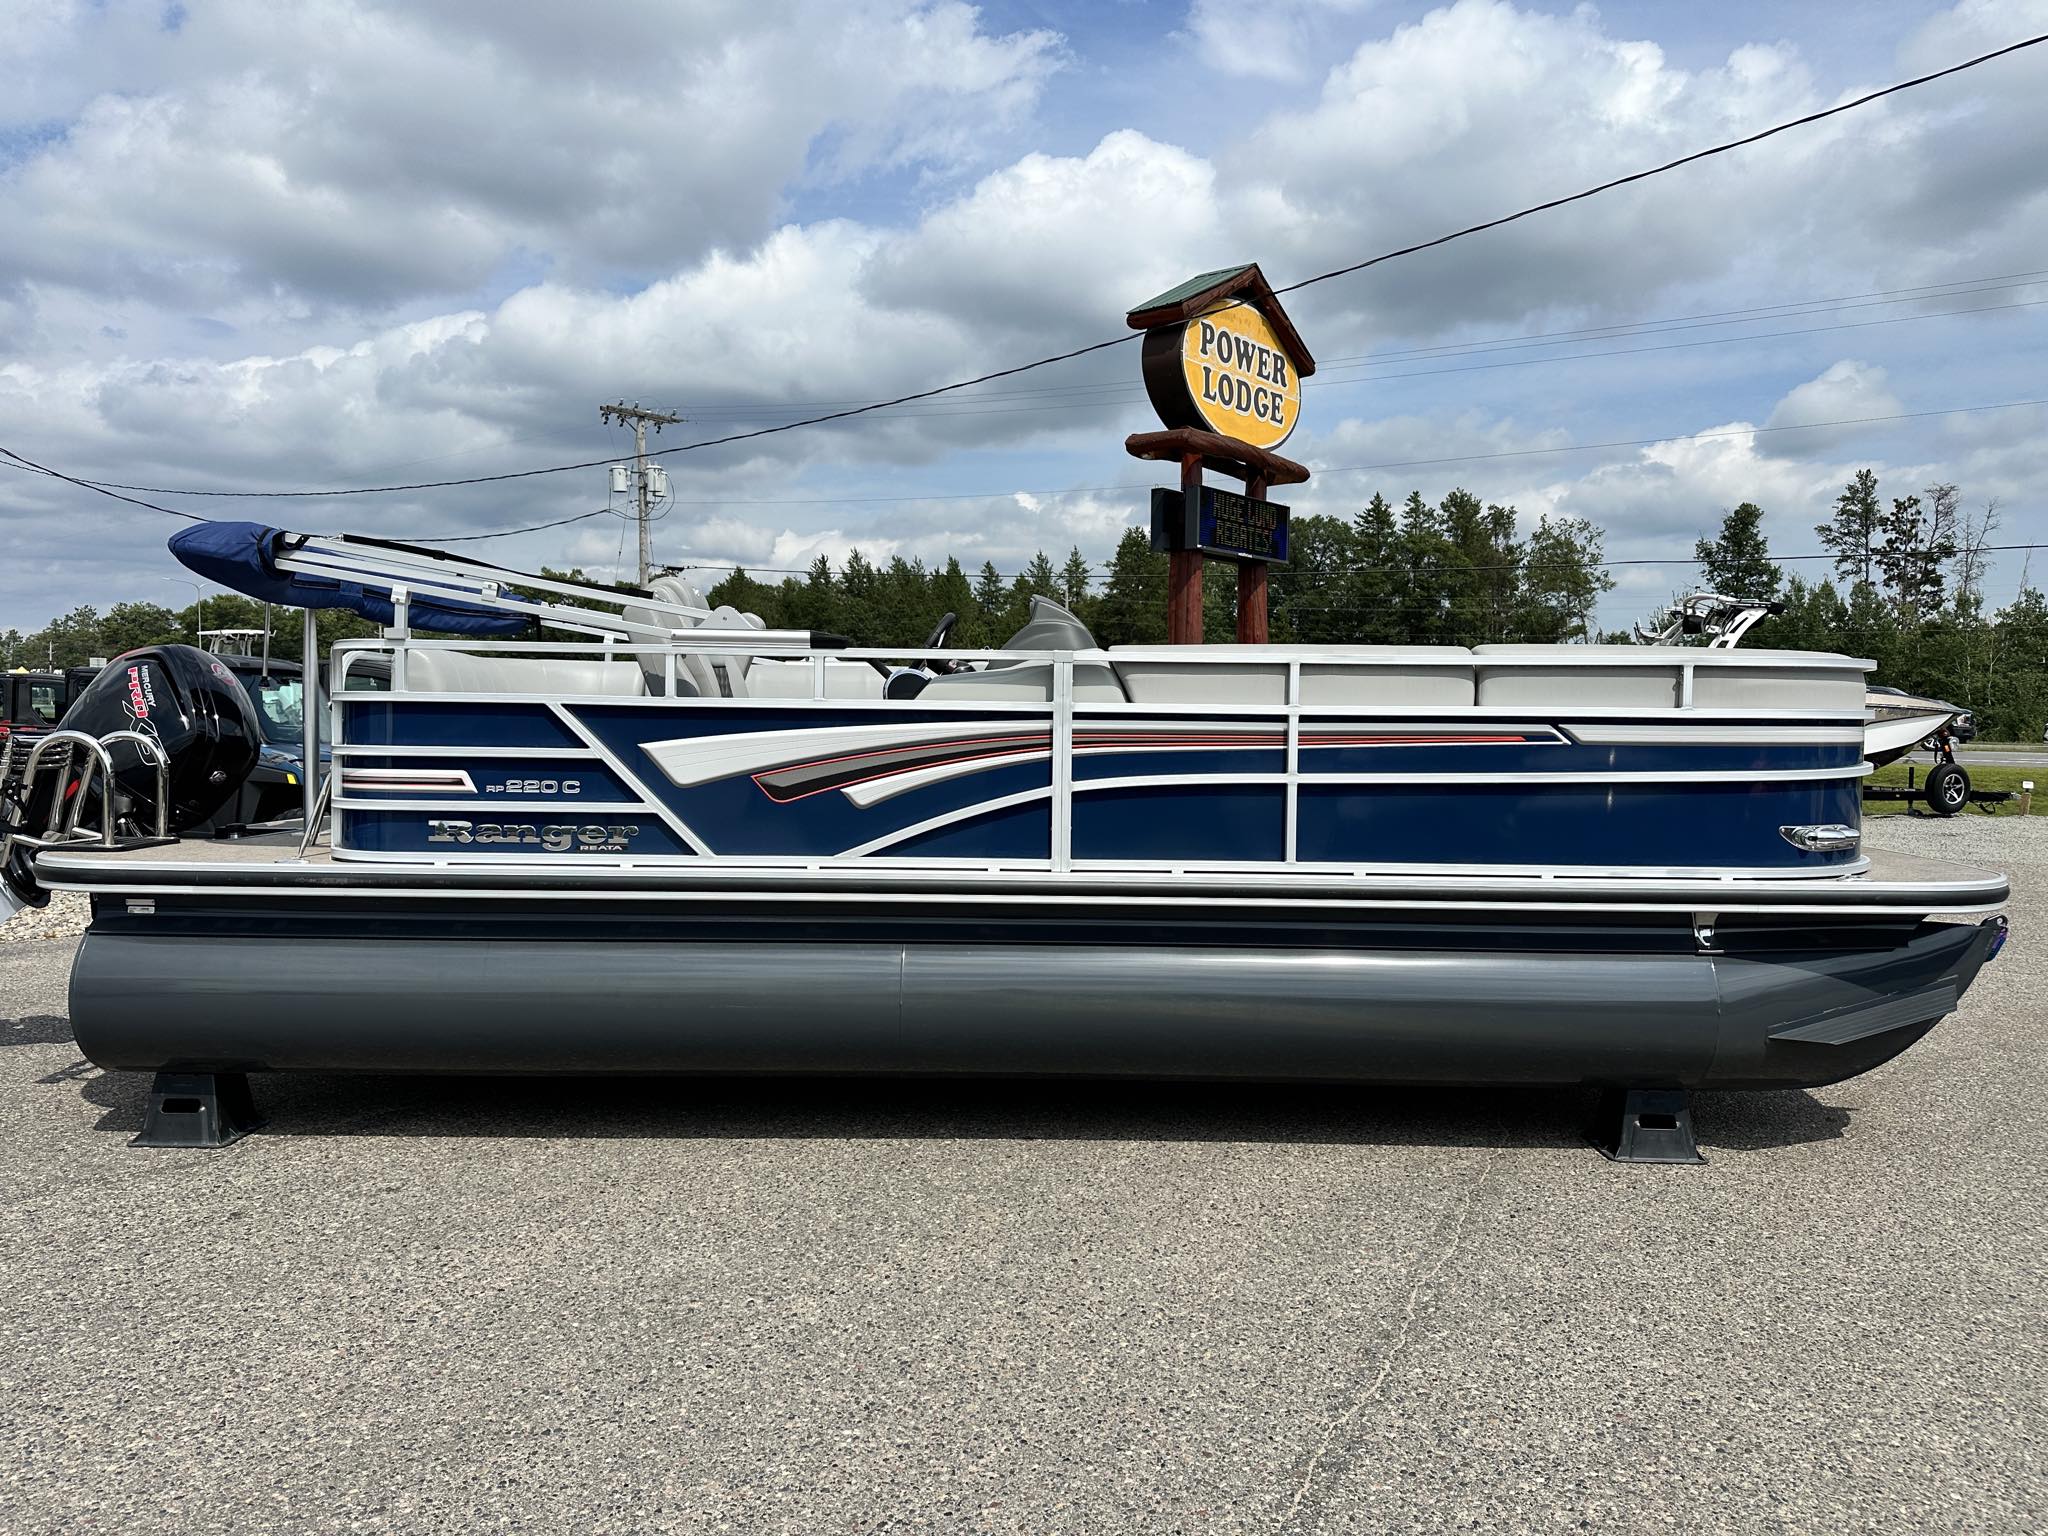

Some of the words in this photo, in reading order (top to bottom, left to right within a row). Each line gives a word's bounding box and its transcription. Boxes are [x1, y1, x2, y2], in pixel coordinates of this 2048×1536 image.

[1200, 320, 1287, 388] POWER
[1203, 366, 1284, 425] LODGE
[127, 667, 149, 719] PRO
[141, 665, 157, 708] MERCURY
[427, 820, 640, 852] Ranger
